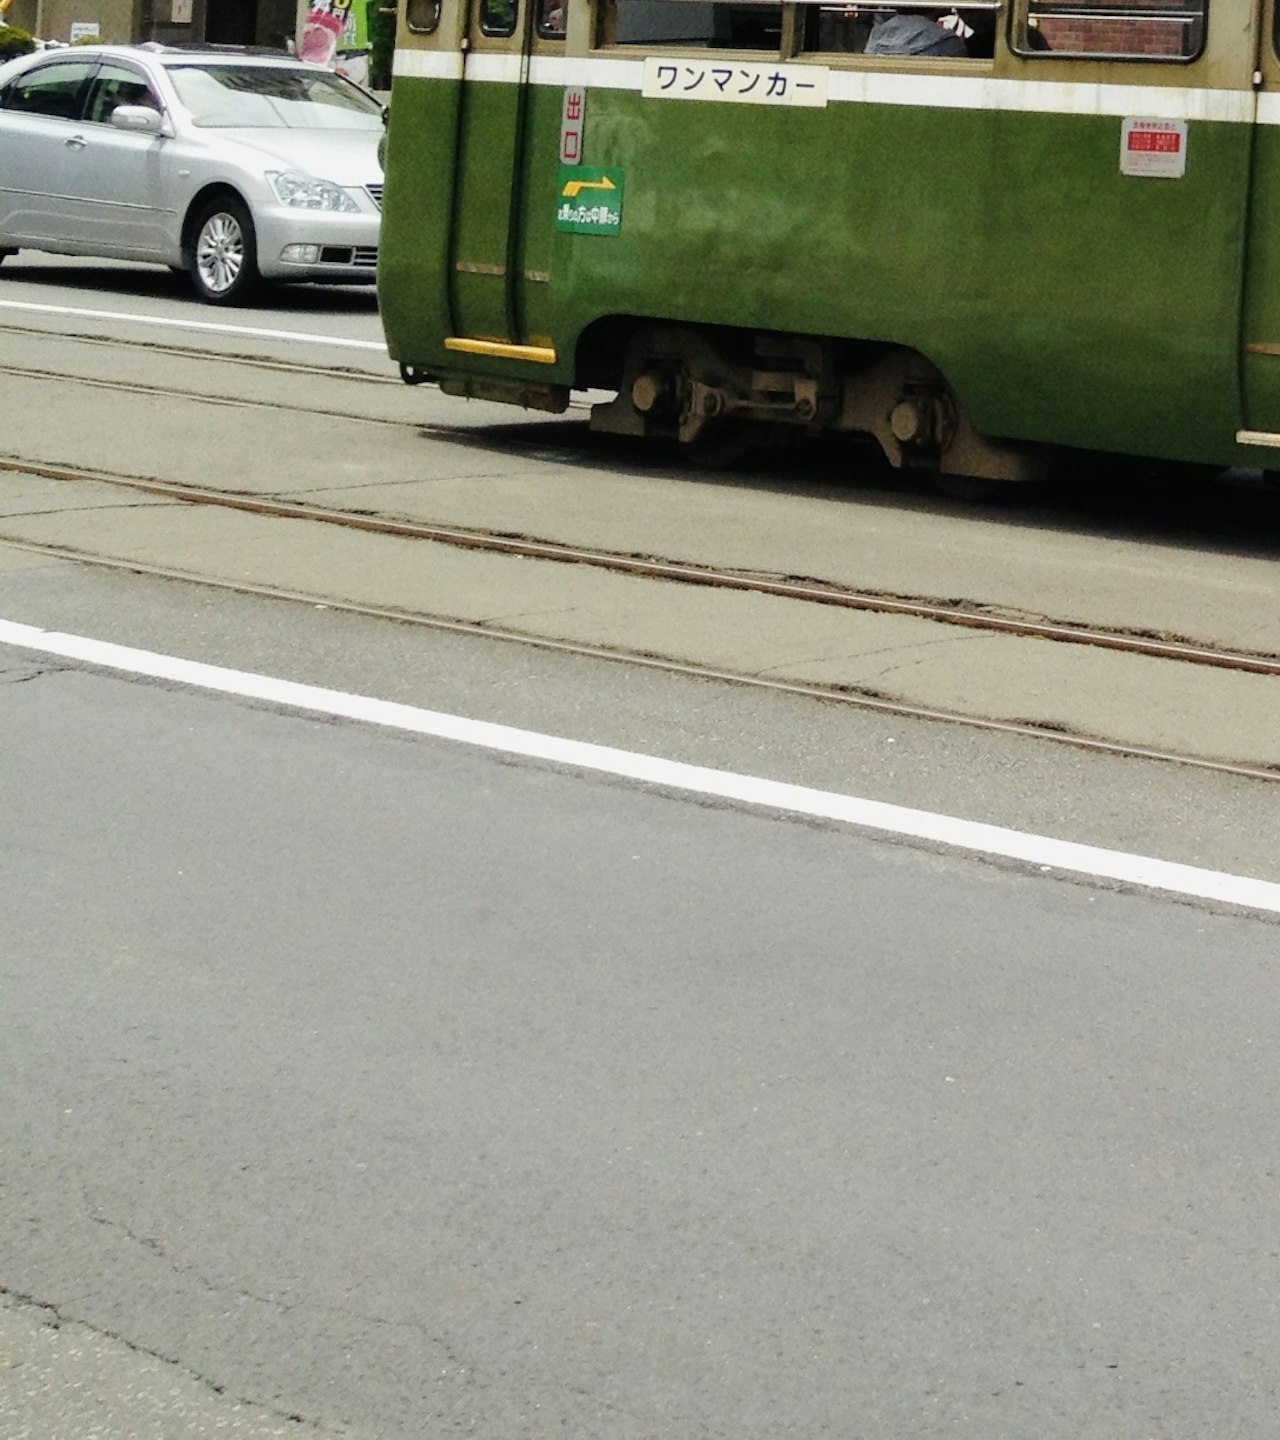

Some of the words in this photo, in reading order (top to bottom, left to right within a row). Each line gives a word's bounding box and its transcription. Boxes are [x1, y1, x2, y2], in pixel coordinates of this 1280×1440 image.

[657, 65, 815, 96] ワンマンカー
[563, 92, 581, 160] 出口
